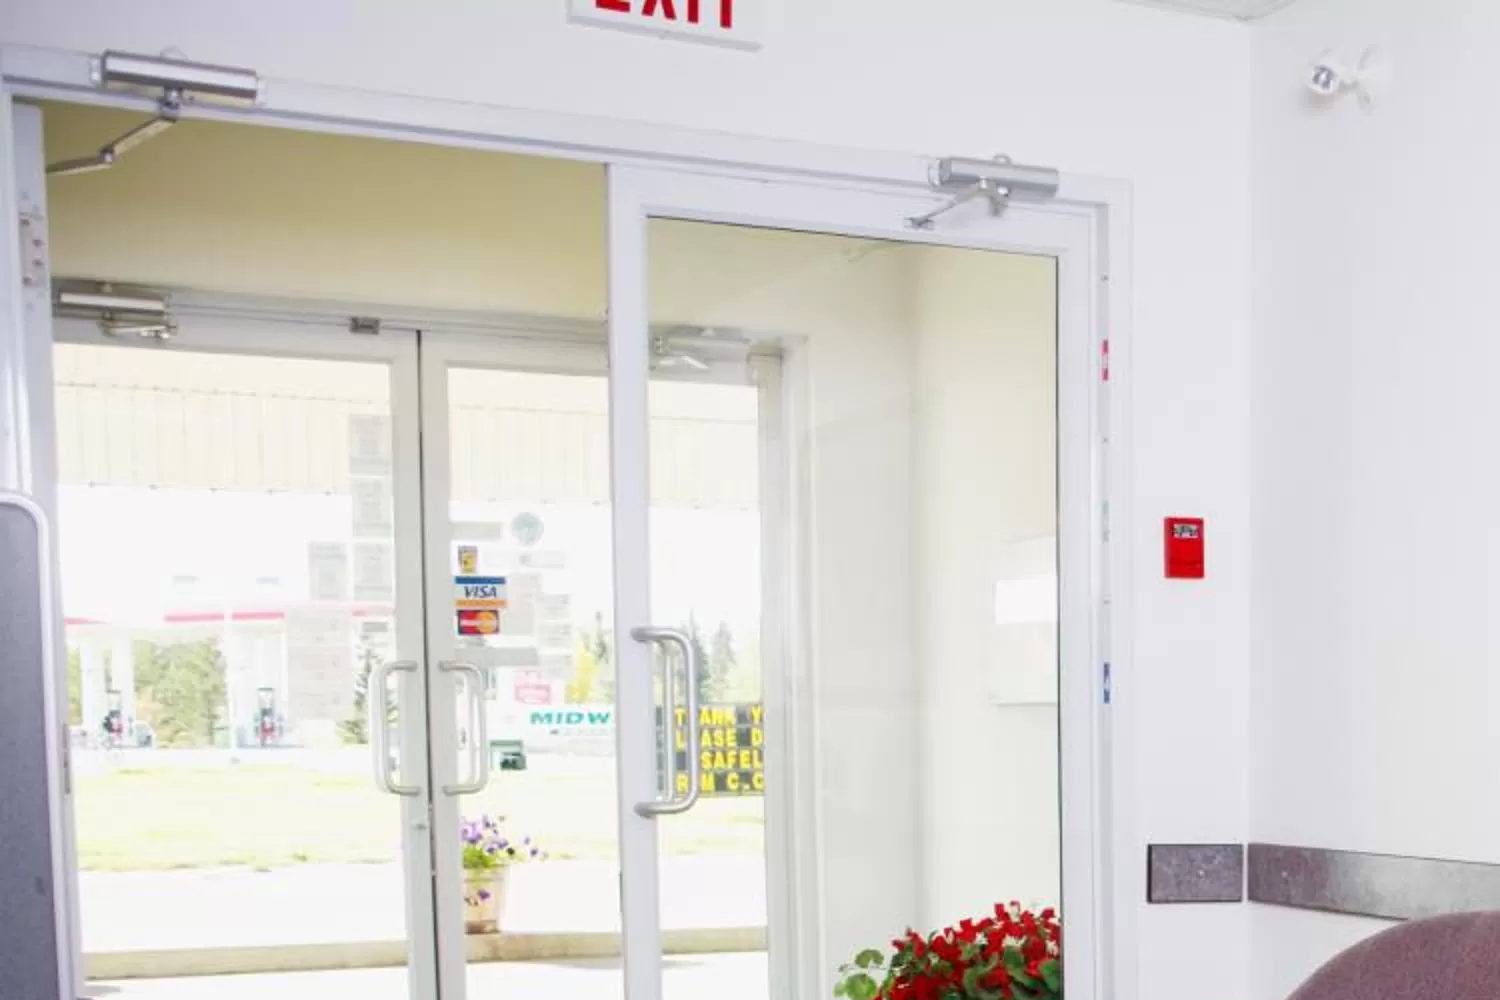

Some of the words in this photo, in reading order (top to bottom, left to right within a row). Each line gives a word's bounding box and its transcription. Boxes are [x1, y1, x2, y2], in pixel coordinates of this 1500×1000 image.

[595, 0, 732, 29] IT
[463, 585, 498, 599] VISA
[530, 711, 609, 724] MIDW
[674, 704, 736, 725] TANK
